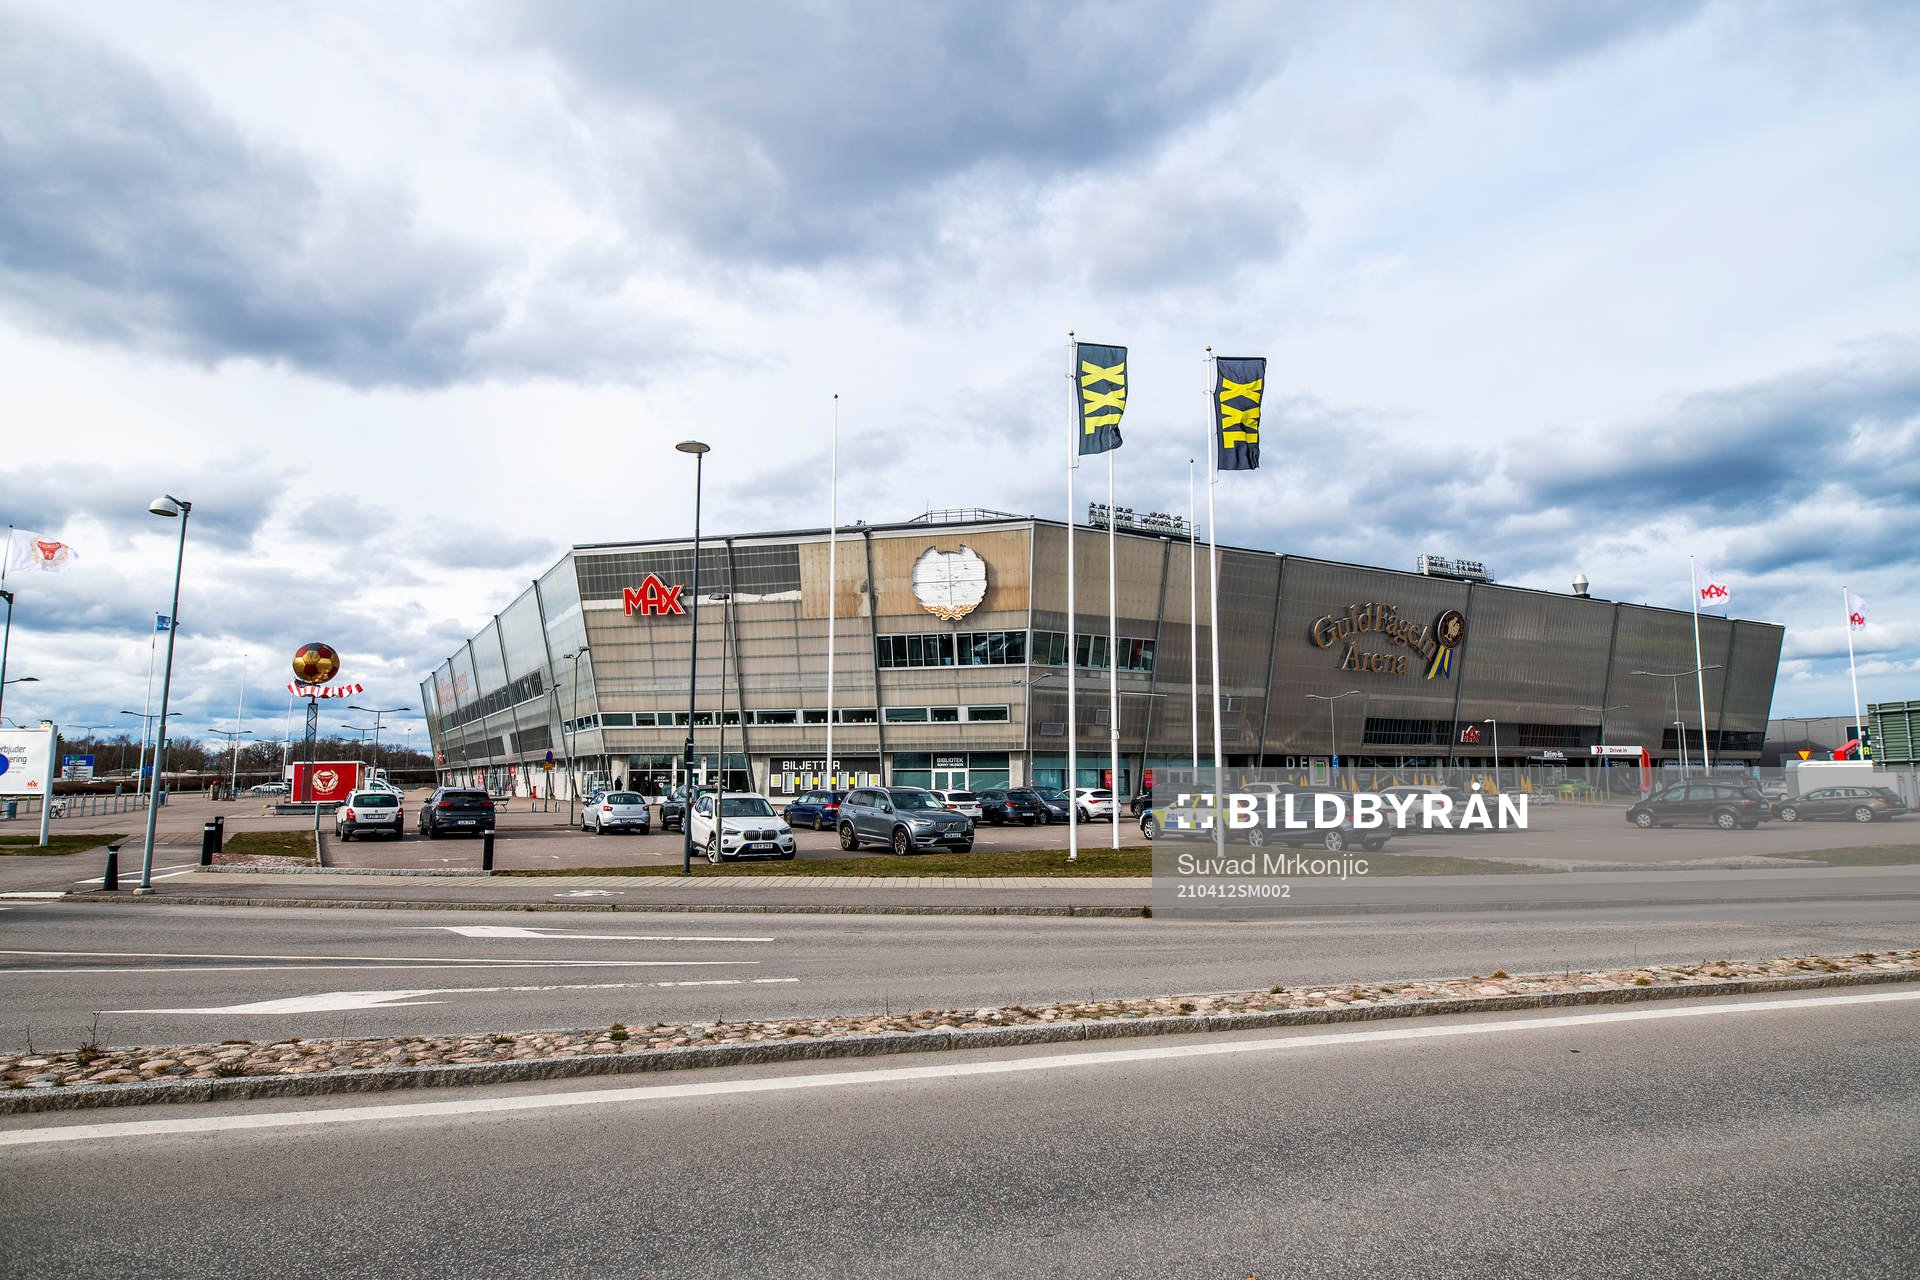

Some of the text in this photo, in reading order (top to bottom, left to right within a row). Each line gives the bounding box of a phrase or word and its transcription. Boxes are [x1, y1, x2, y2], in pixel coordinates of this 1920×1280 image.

[1081, 360, 1125, 435] XXL
[1220, 378, 1263, 449] XXL
[623, 572, 686, 616] MAX
[1701, 584, 1728, 599] MAX
[1341, 640, 1408, 674] Arena
[783, 760, 840, 770] BILJETTR
